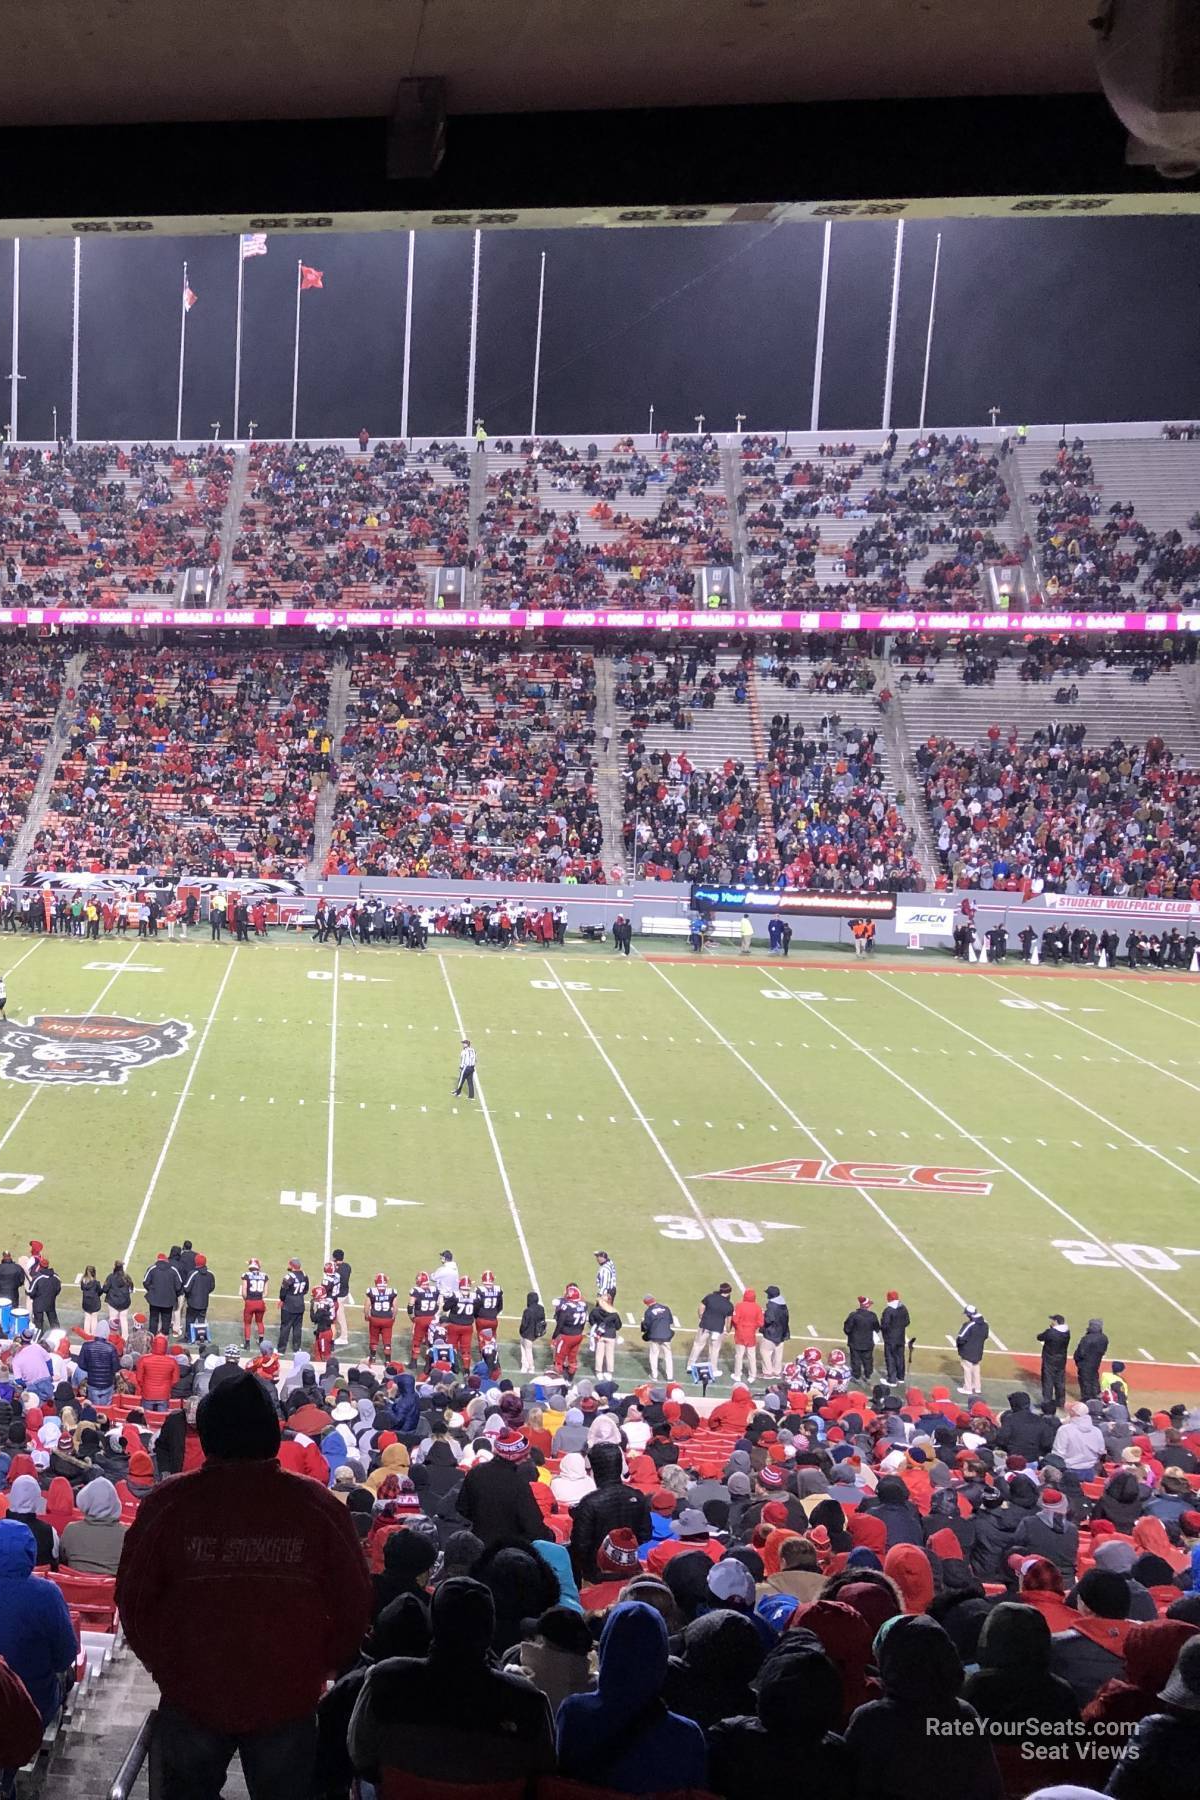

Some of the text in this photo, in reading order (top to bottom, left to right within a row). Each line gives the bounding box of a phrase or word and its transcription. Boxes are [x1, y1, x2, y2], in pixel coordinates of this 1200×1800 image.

[562, 614, 594, 627] AUTO
[721, 891, 745, 903] Your
[1059, 897, 1192, 913] STUDENT WOLFPACK CLUB
[910, 914, 947, 923] ACCN
[307, 970, 367, 982] 40
[530, 979, 593, 992] 30
[760, 989, 829, 1001] 20
[1001, 998, 1071, 1011] 10
[47, 1023, 136, 1038] NC STATE
[688, 1158, 1005, 1195] ACC
[279, 1191, 378, 1219] 40
[653, 1214, 766, 1244] 30
[1049, 1239, 1183, 1271] 20
[457, 1304, 474, 1315] 70
[573, 1312, 586, 1325] 73
